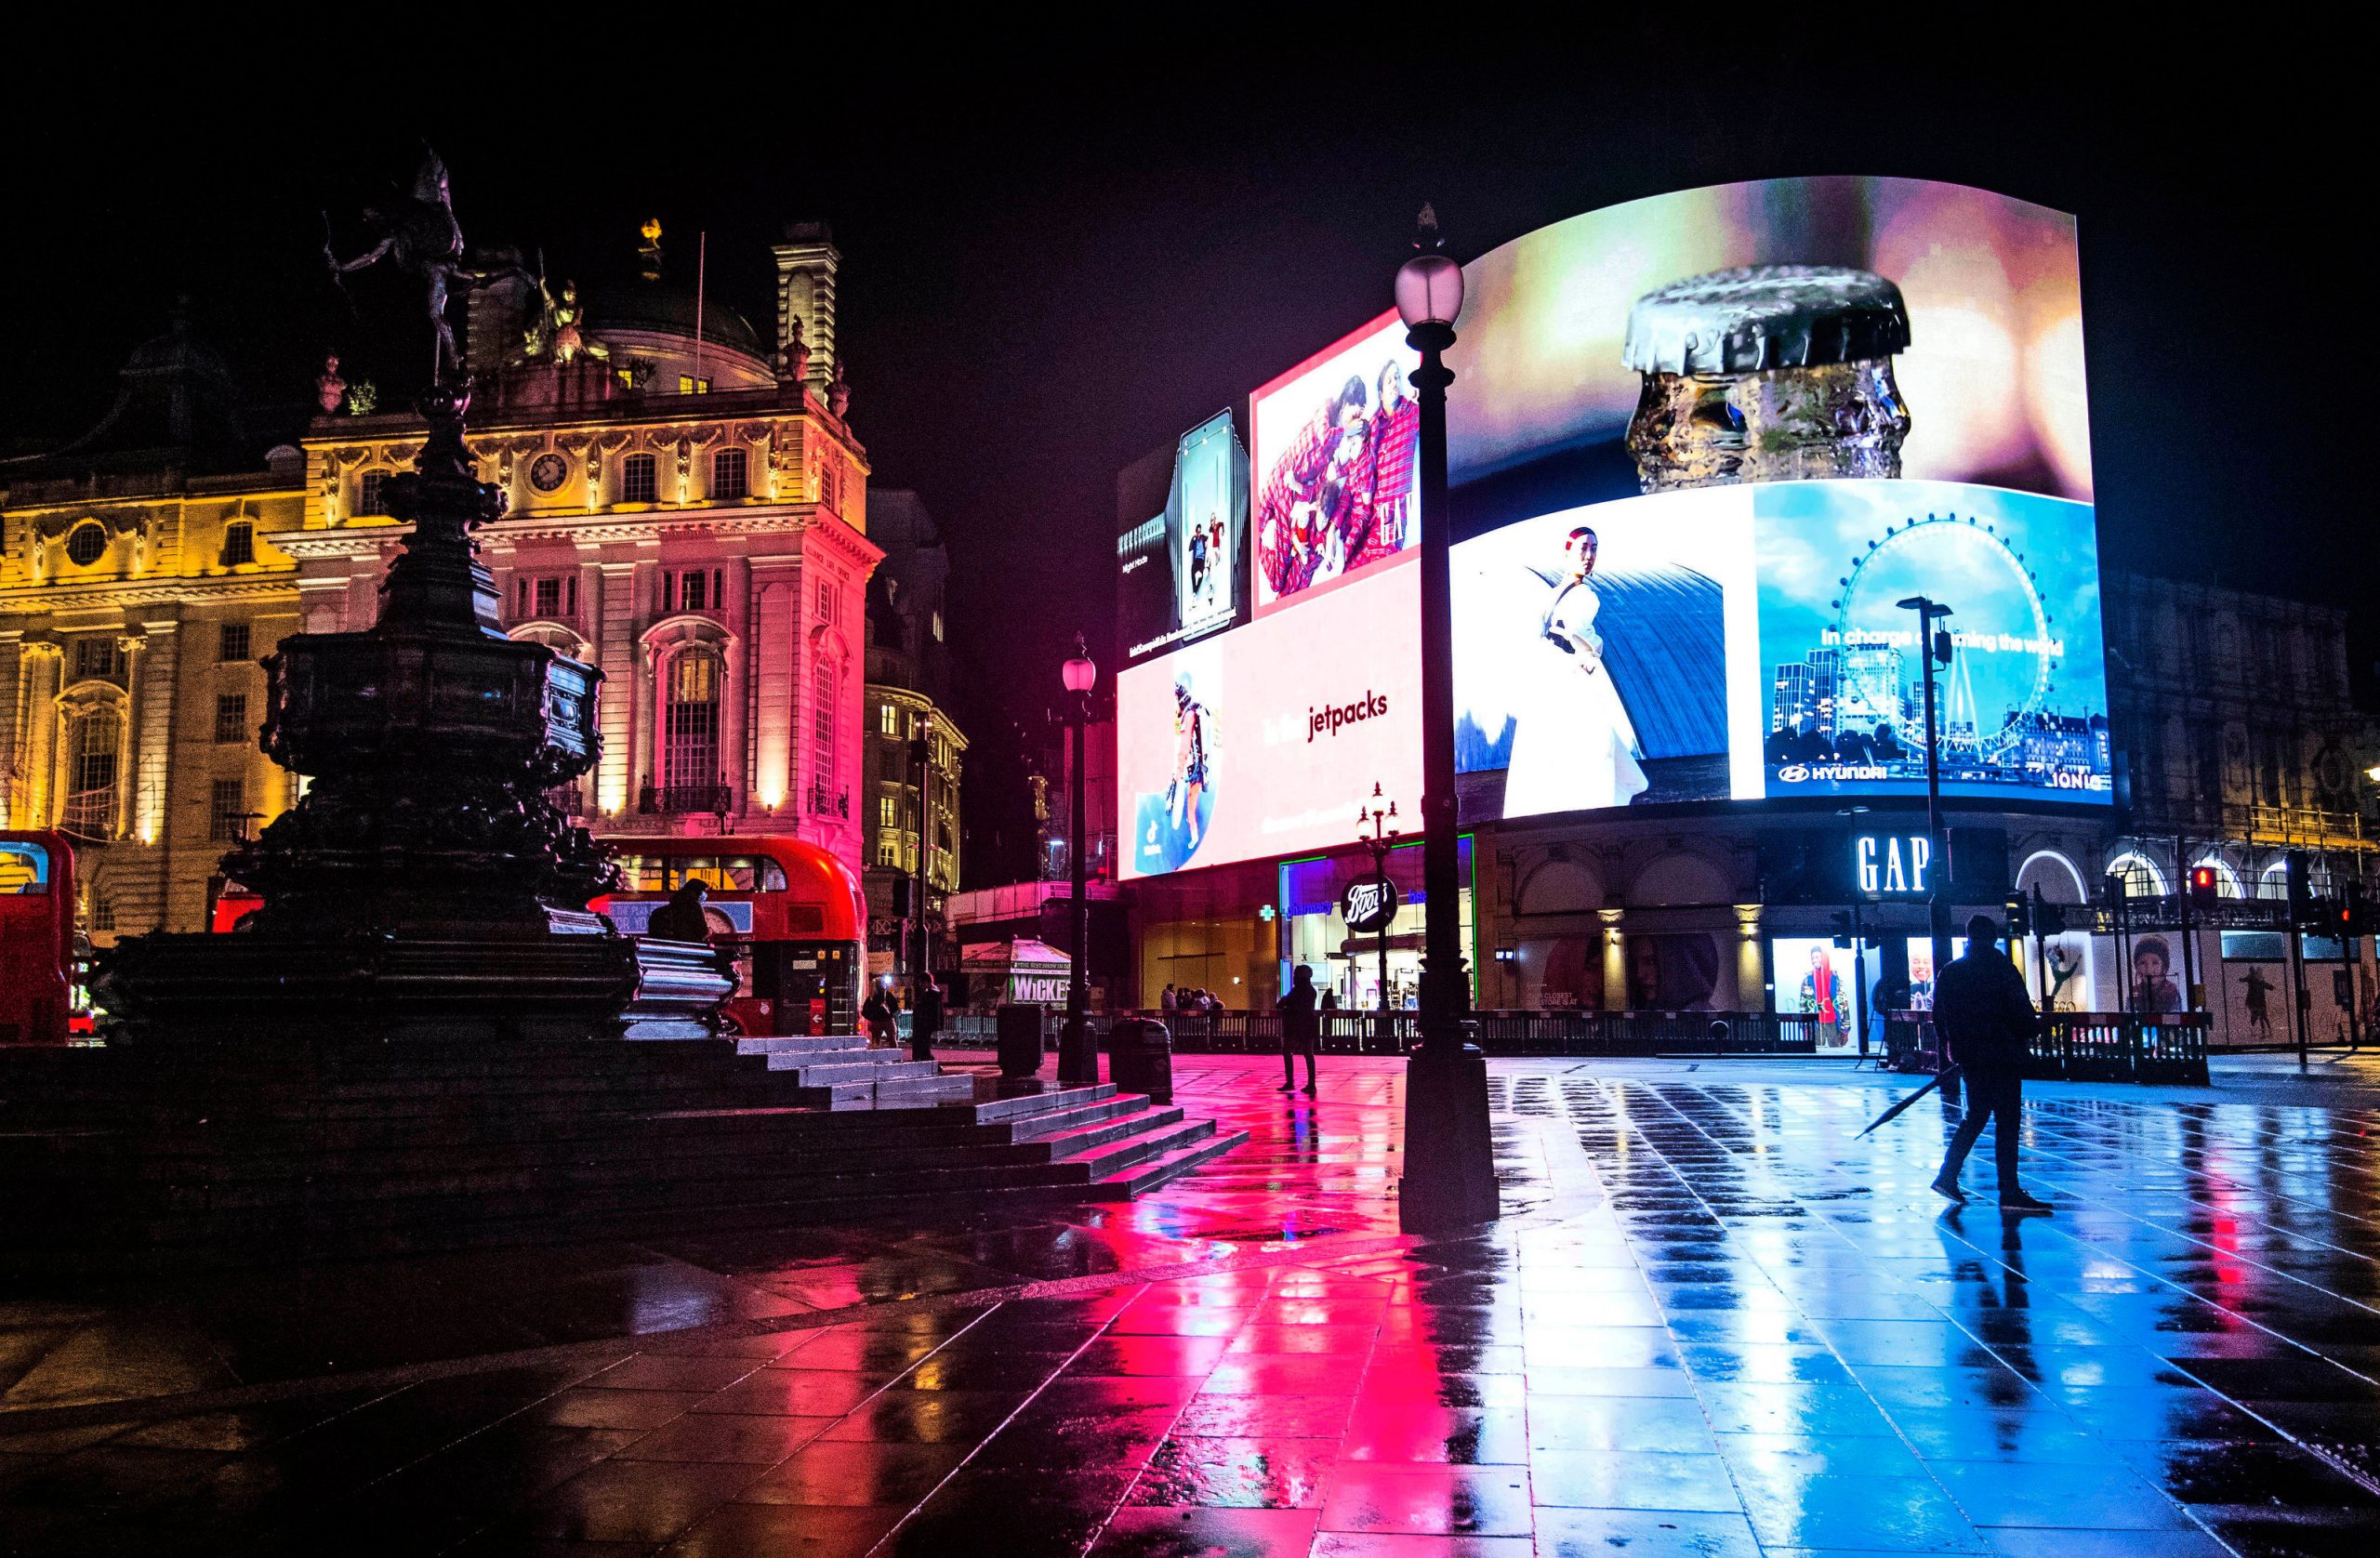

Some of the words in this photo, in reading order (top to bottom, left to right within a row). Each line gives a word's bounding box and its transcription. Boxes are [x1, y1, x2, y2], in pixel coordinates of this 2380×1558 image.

[1844, 628, 1912, 648] charge
[1998, 633, 2023, 652] the
[1307, 690, 1387, 743] jetpacks
[1812, 767, 1887, 779] HYUNDAI
[1858, 838, 1930, 891] GAP
[1288, 901, 1333, 919] pharmacy
[1013, 974, 1071, 1001] WiCKE
